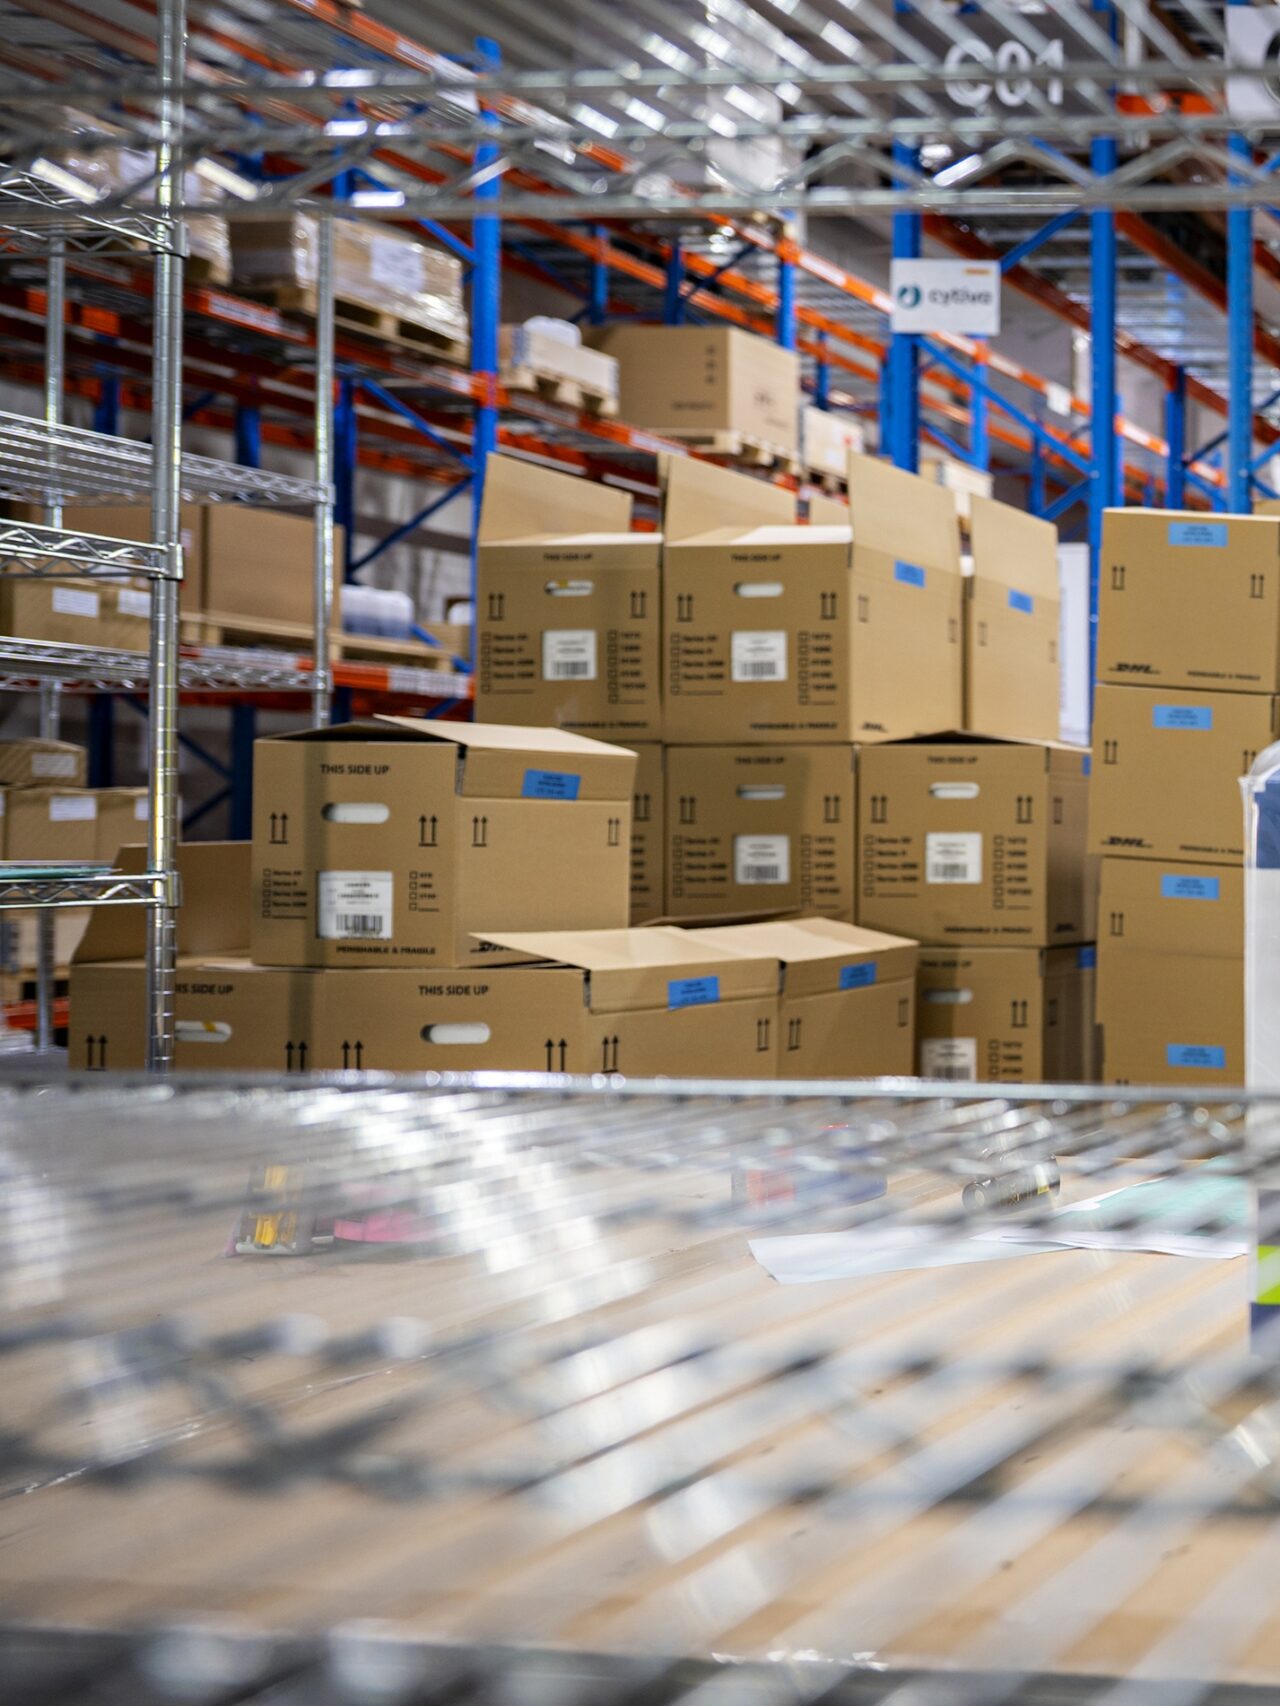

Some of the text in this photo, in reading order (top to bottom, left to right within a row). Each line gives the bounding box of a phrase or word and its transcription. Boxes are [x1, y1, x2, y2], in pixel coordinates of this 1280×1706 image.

[321, 764, 390, 776] THIS SIDE UP
[191, 984, 216, 995] SIDE
[218, 985, 234, 995] UP
[418, 985, 488, 996] THIS SIDE UP
